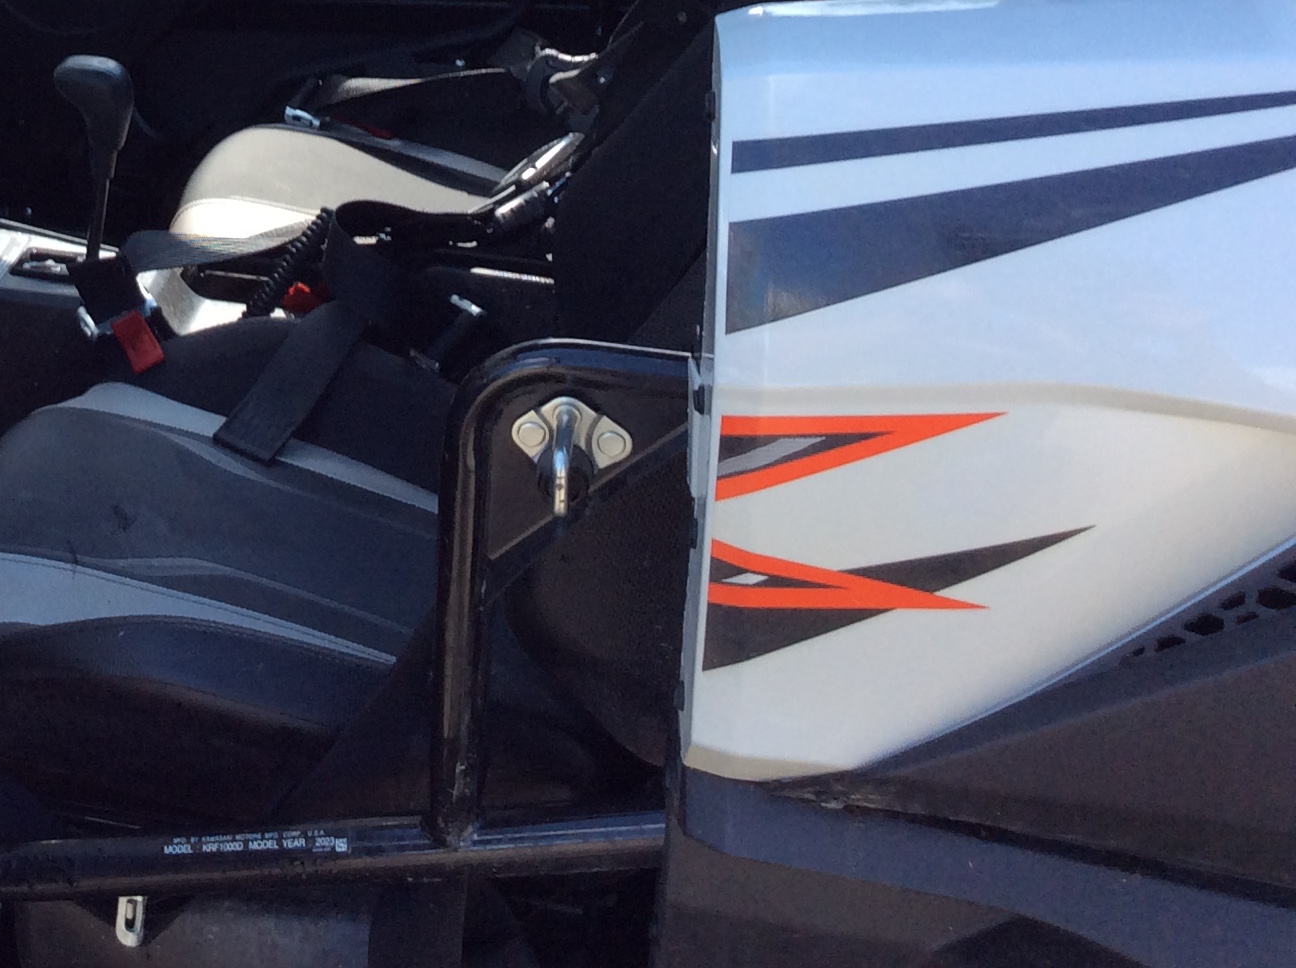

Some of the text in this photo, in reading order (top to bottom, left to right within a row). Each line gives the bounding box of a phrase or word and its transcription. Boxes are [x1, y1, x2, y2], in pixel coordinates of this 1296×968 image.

[164, 844, 193, 854] MODEL
[249, 840, 279, 850] MODEL
[282, 838, 306, 849] YEAR
[315, 836, 335, 847] 2023
